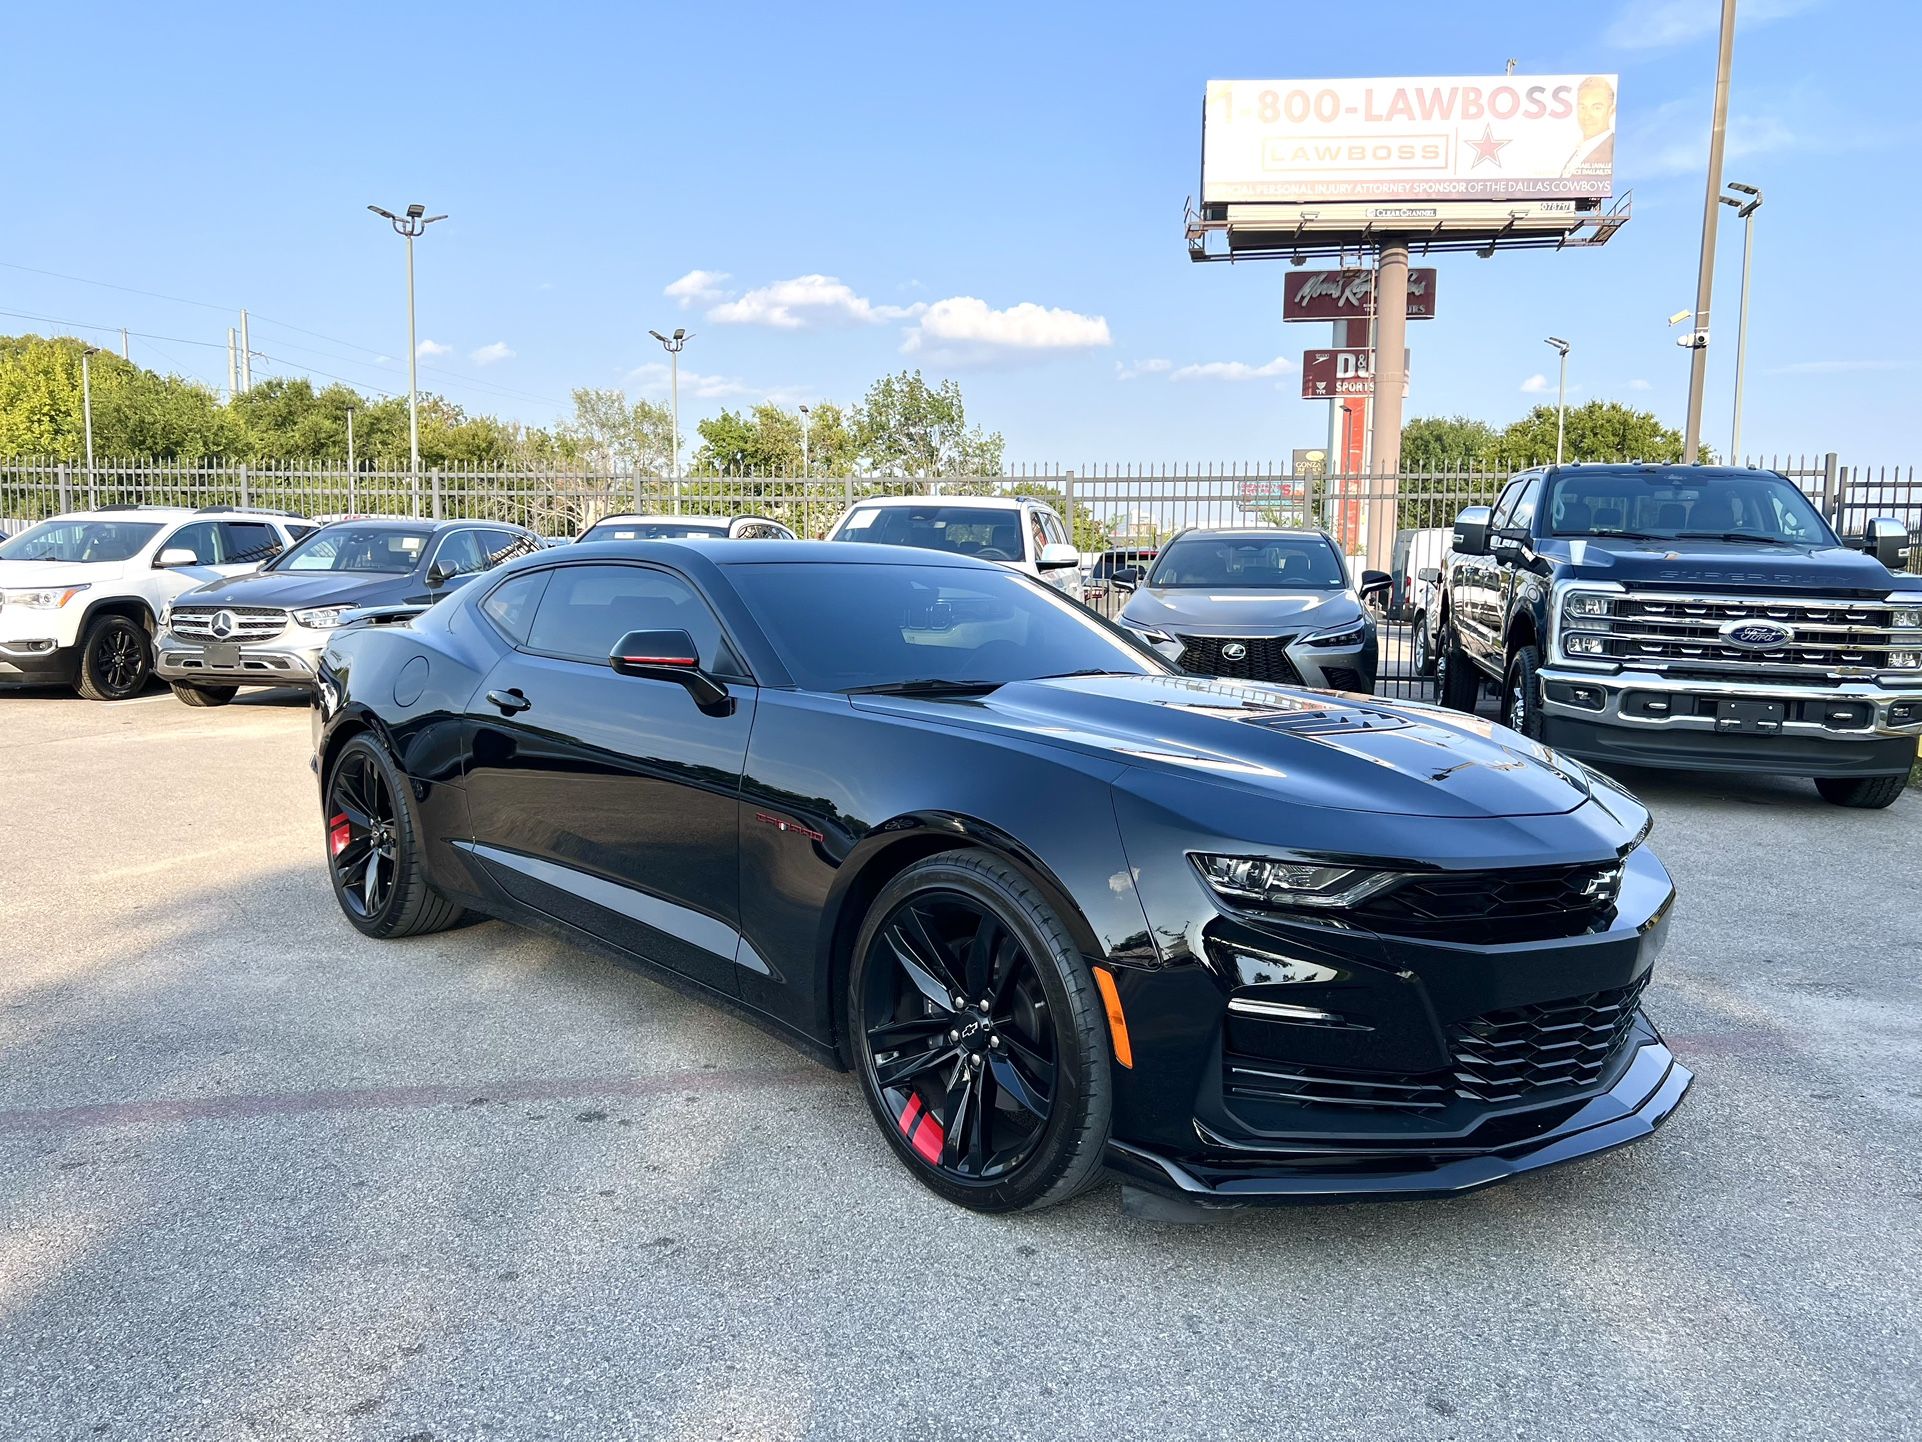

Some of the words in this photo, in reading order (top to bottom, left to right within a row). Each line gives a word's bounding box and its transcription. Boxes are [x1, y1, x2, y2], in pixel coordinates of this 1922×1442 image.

[1269, 142, 1441, 163] LAWBOSS
[1315, 183, 1351, 194] INJURY
[1354, 182, 1412, 194] ATTORNEY
[1413, 183, 1466, 193] SPONSOR
[1468, 182, 1485, 193] OF
[1485, 182, 1506, 192] THE
[1508, 181, 1550, 192] DALLAS
[1551, 180, 1611, 192] COWBOYS
[1740, 627, 1776, 643] Ford
